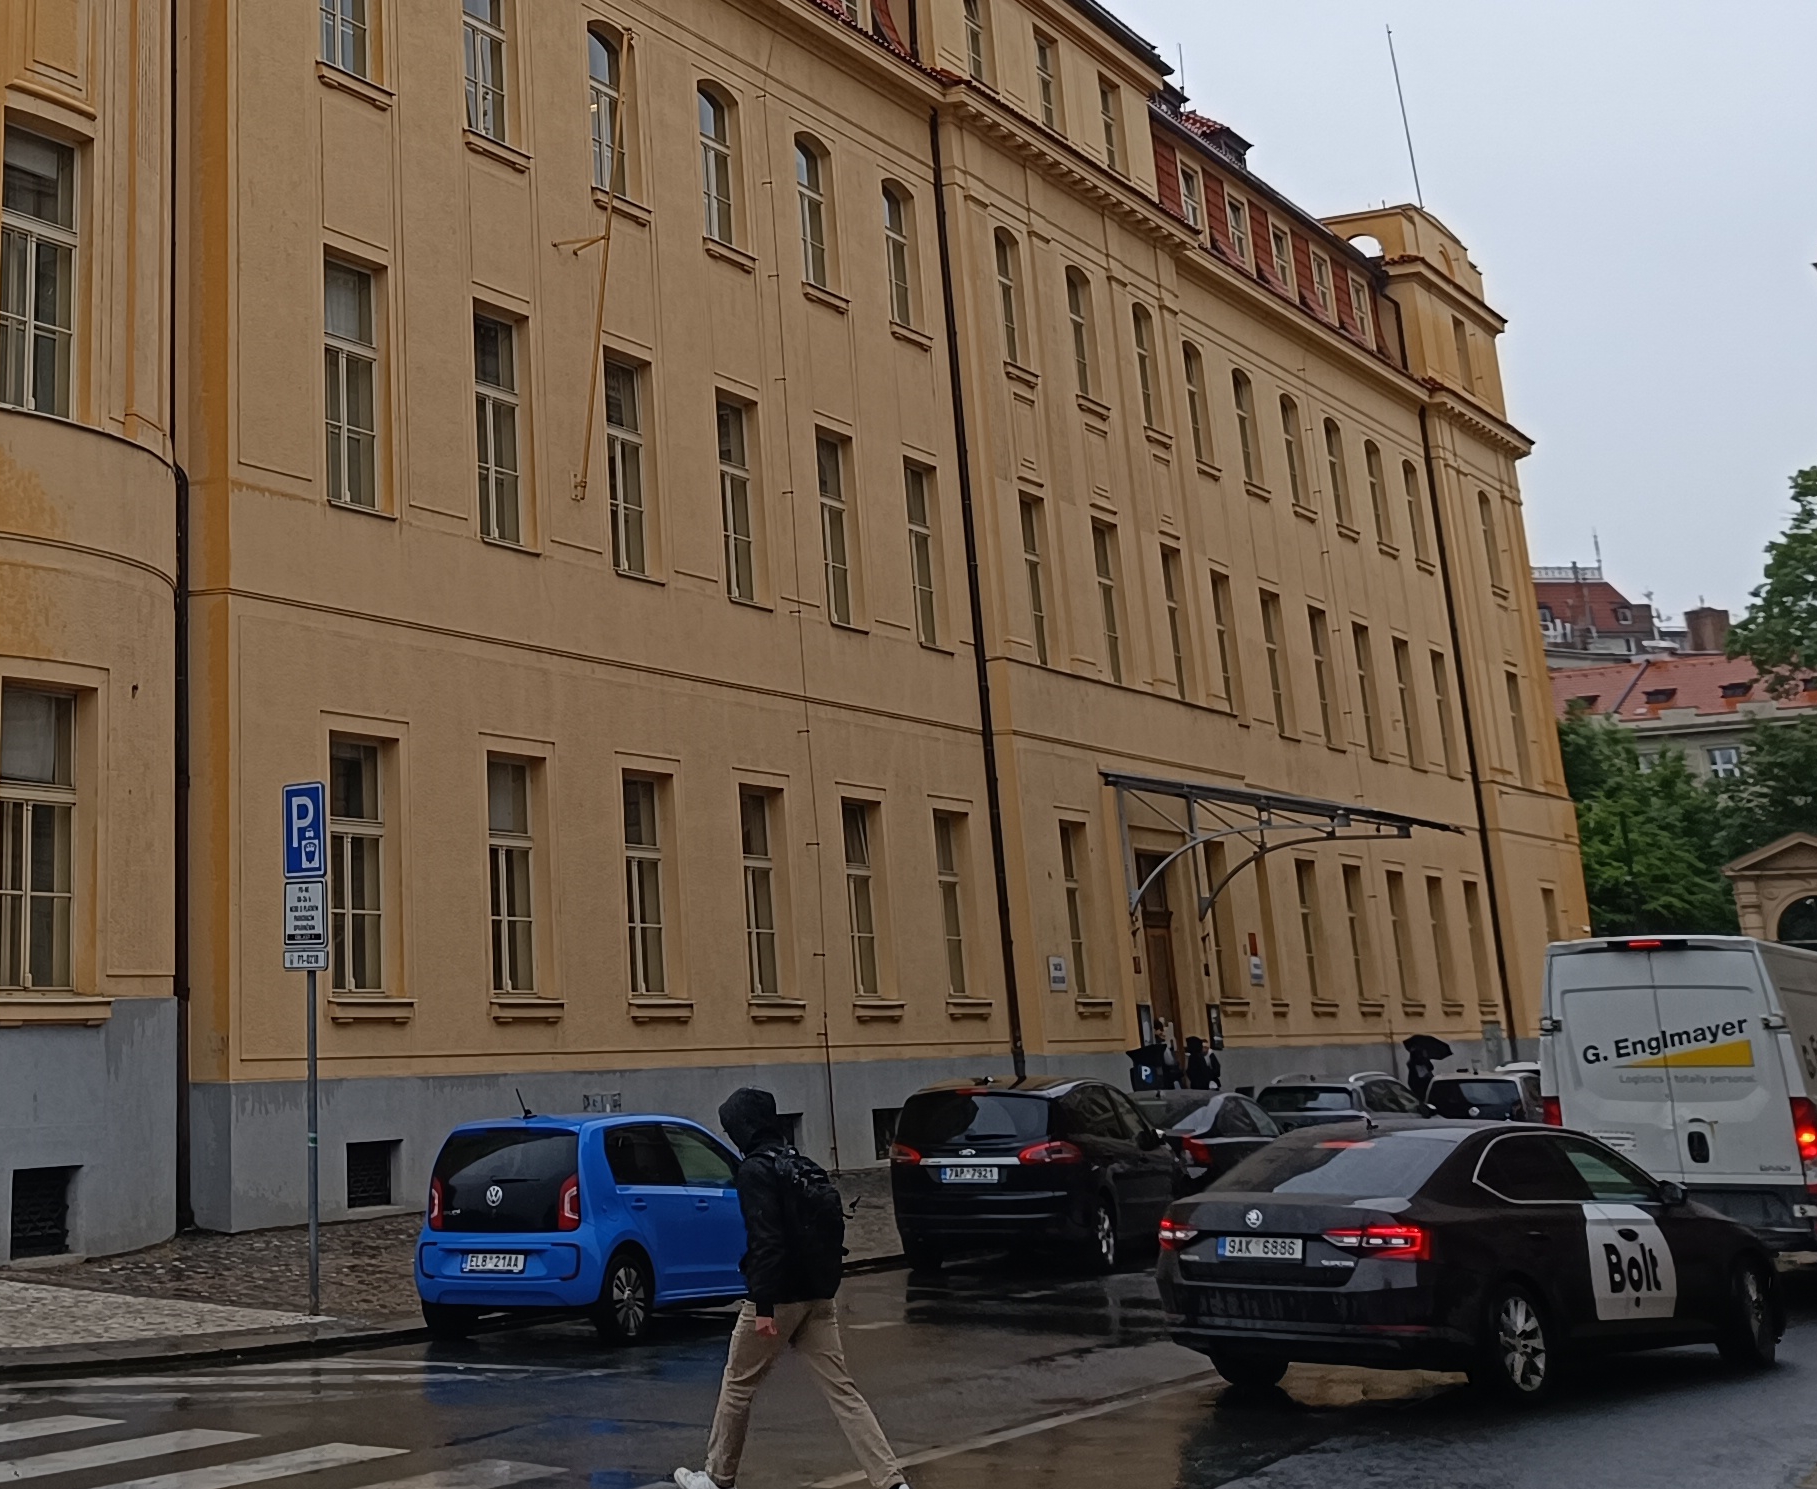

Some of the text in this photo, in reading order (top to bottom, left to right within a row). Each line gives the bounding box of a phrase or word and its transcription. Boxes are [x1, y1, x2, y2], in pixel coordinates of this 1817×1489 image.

[291, 796, 314, 848] P
[1583, 1018, 1748, 1064] G. Englmayer
[1603, 1242, 1662, 1294] Bolt
